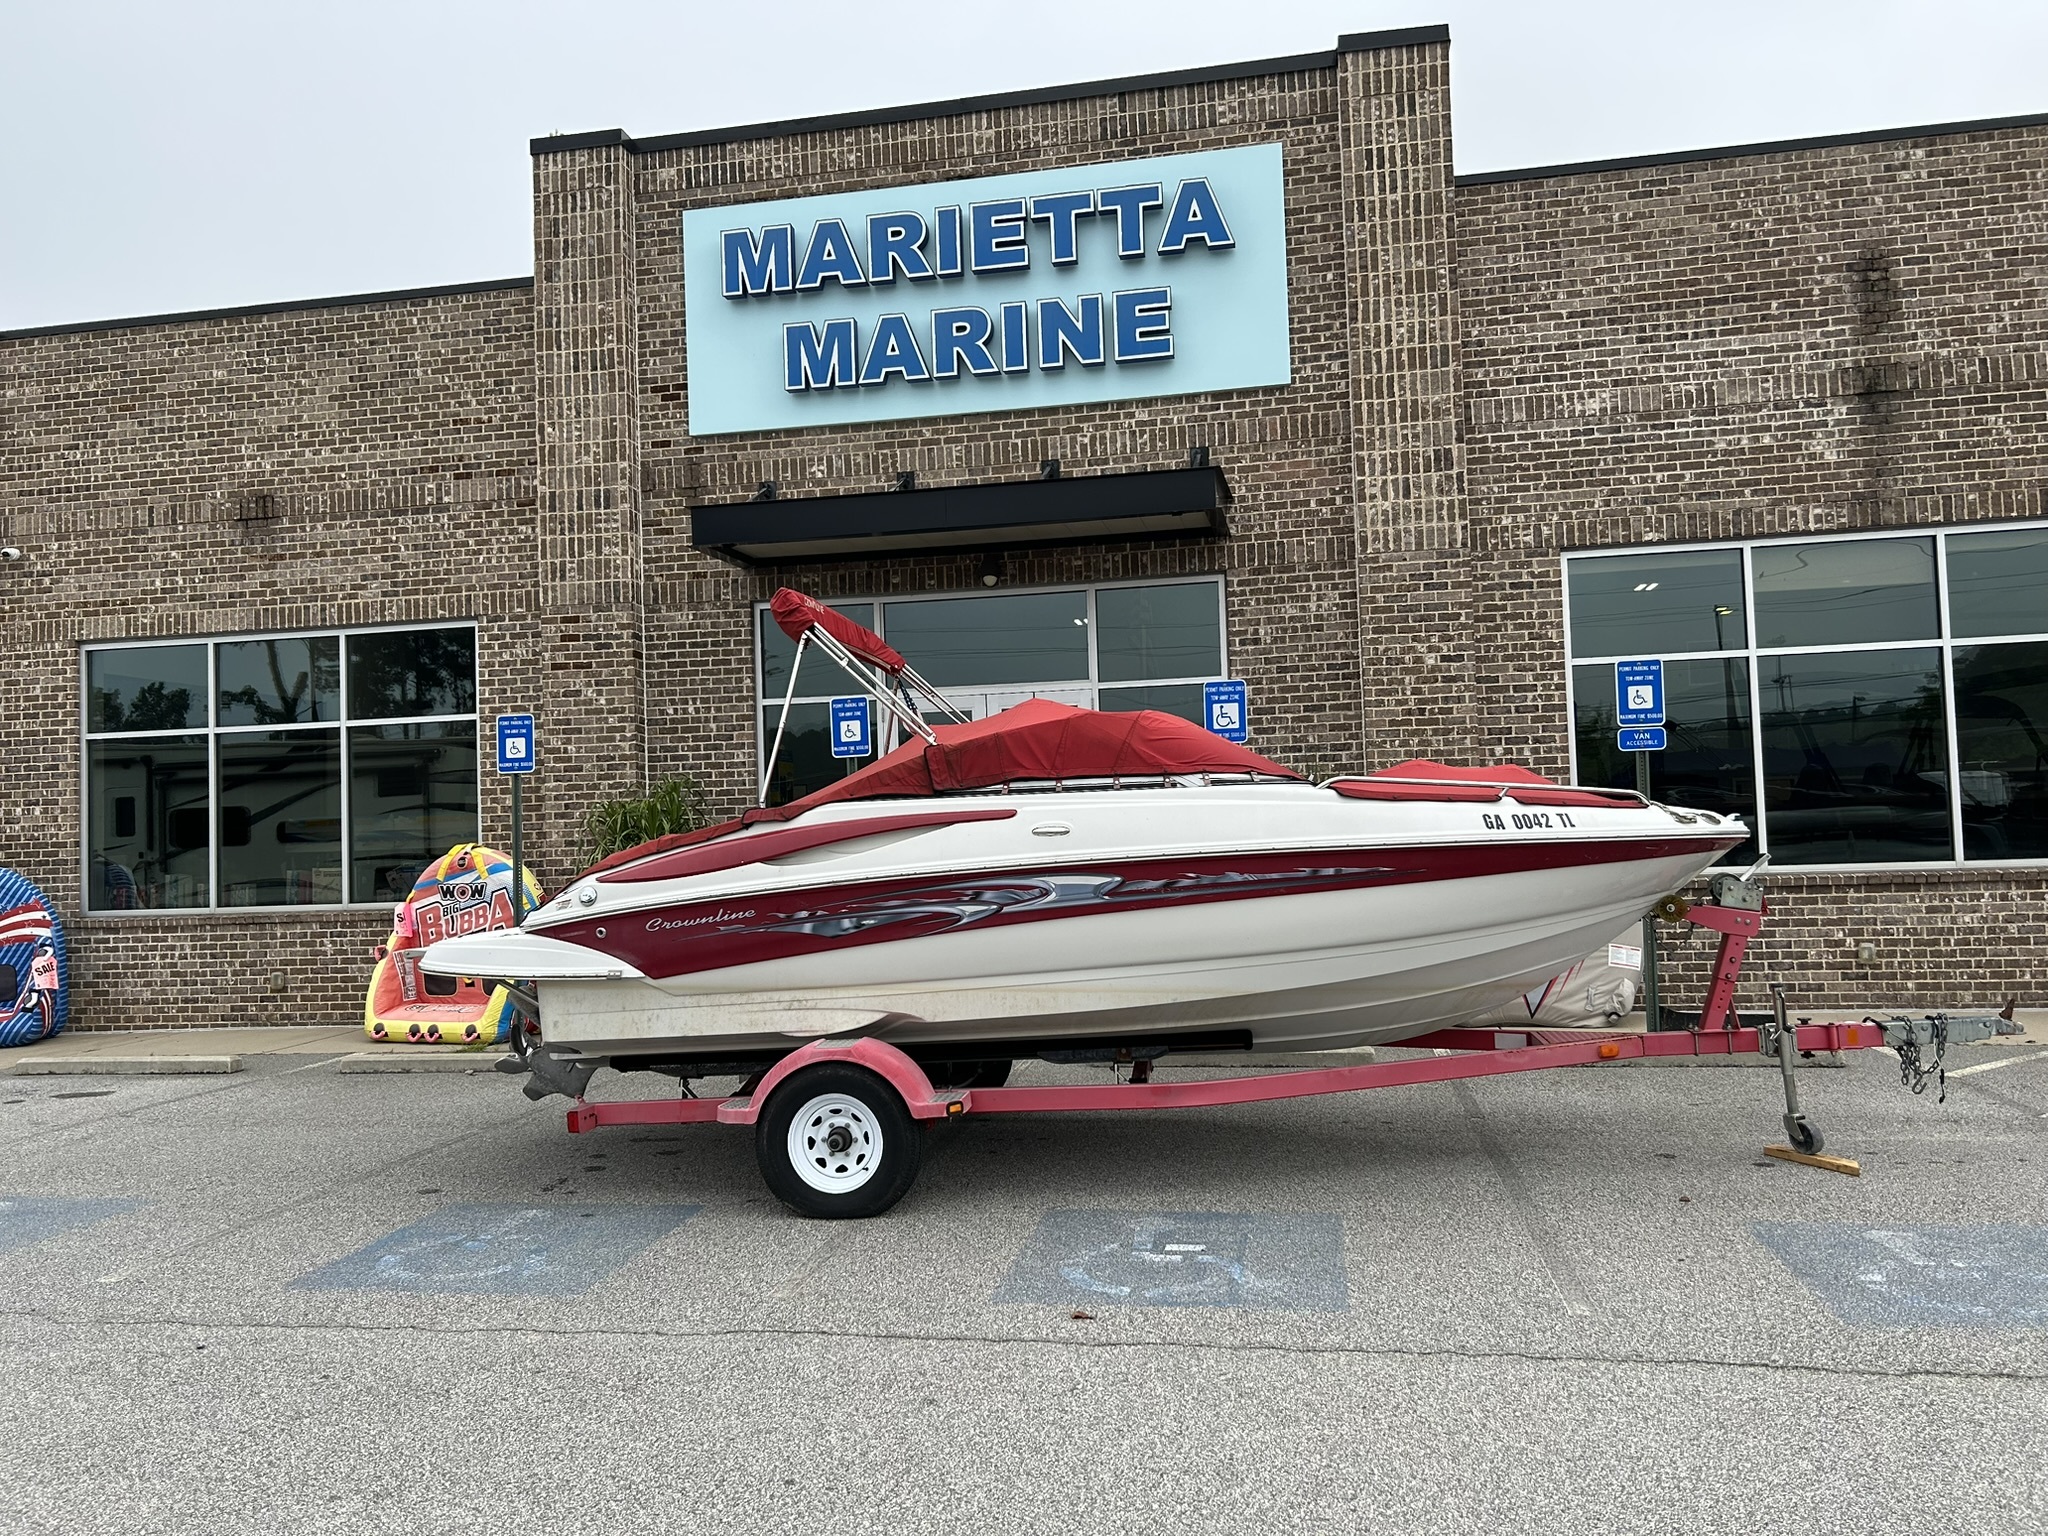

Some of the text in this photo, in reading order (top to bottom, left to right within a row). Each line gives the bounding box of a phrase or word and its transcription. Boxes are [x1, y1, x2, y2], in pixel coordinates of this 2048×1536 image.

[720, 177, 1236, 300] MARIETTA
[783, 285, 1176, 394] MARINE
[1634, 732, 1650, 740] VAN
[1482, 812, 1576, 830] GA 0042 TL
[438, 882, 487, 902] WOW
[416, 888, 515, 947] BUBBA
[442, 902, 460, 918] BIG
[645, 908, 757, 932] Crownline
[35, 961, 56, 977] SALE
